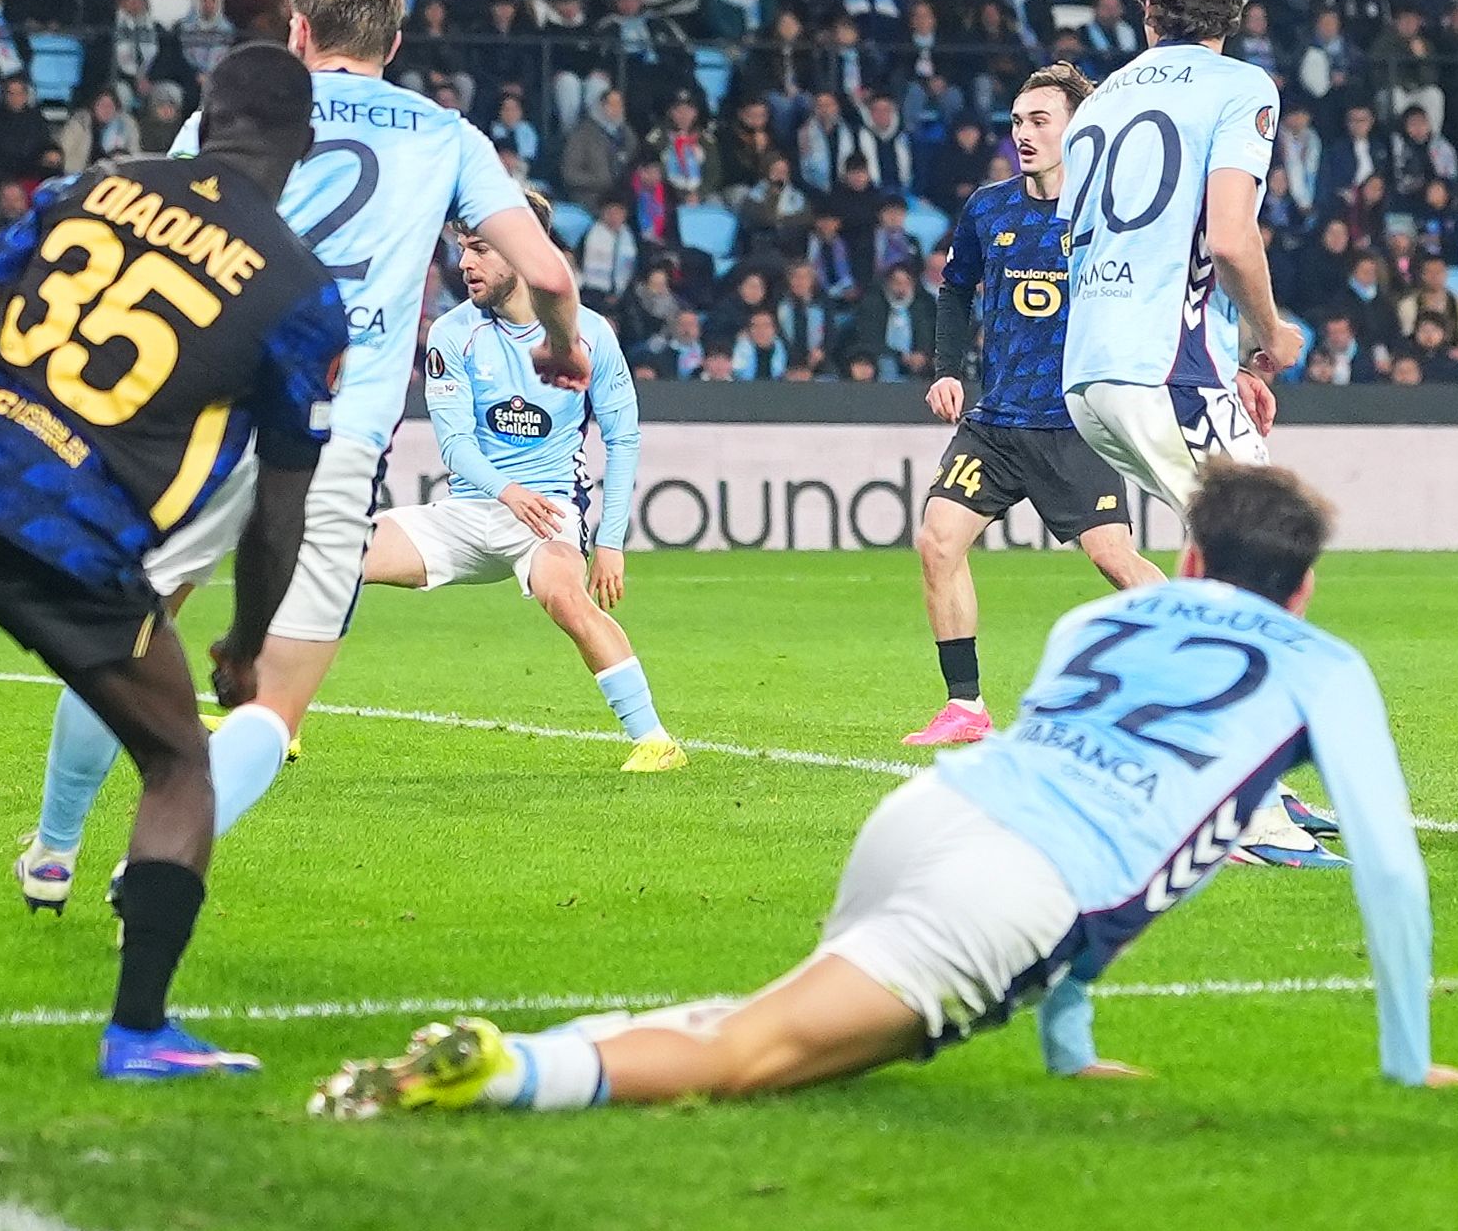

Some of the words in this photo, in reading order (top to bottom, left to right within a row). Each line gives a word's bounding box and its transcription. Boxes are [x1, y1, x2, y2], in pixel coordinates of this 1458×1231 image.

[312, 100, 426, 131] ARFELT
[1068, 110, 1182, 248] 20
[296, 138, 380, 282] 2
[1004, 268, 1070, 282] boulanger
[1078, 260, 1135, 296] ANCA
[494, 408, 542, 424] Estrella
[496, 420, 540, 437] Galicia
[944, 454, 983, 498] 14
[1034, 617, 1270, 772] 32
